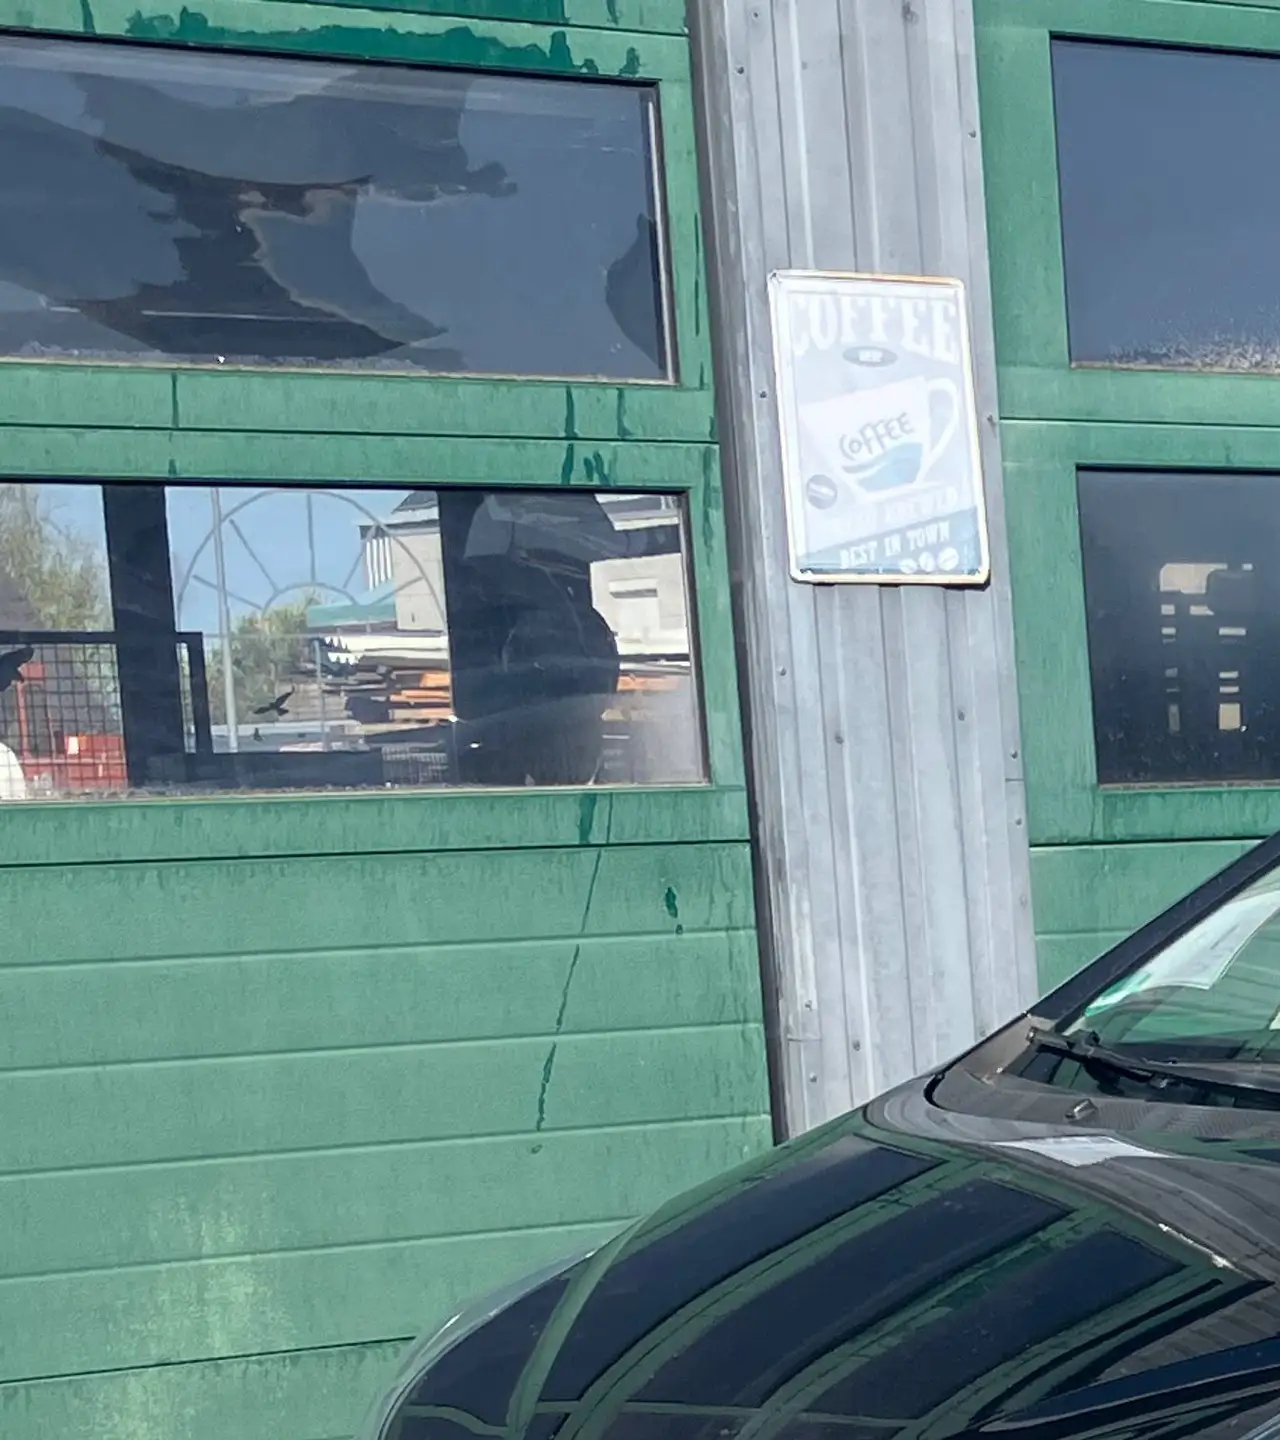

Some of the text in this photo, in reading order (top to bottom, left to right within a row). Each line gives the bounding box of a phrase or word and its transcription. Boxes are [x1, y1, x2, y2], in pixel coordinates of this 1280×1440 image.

[790, 291, 959, 365] COFFEE
[838, 411, 916, 461] COFFEE
[839, 520, 950, 569] BEST IN TOWN
